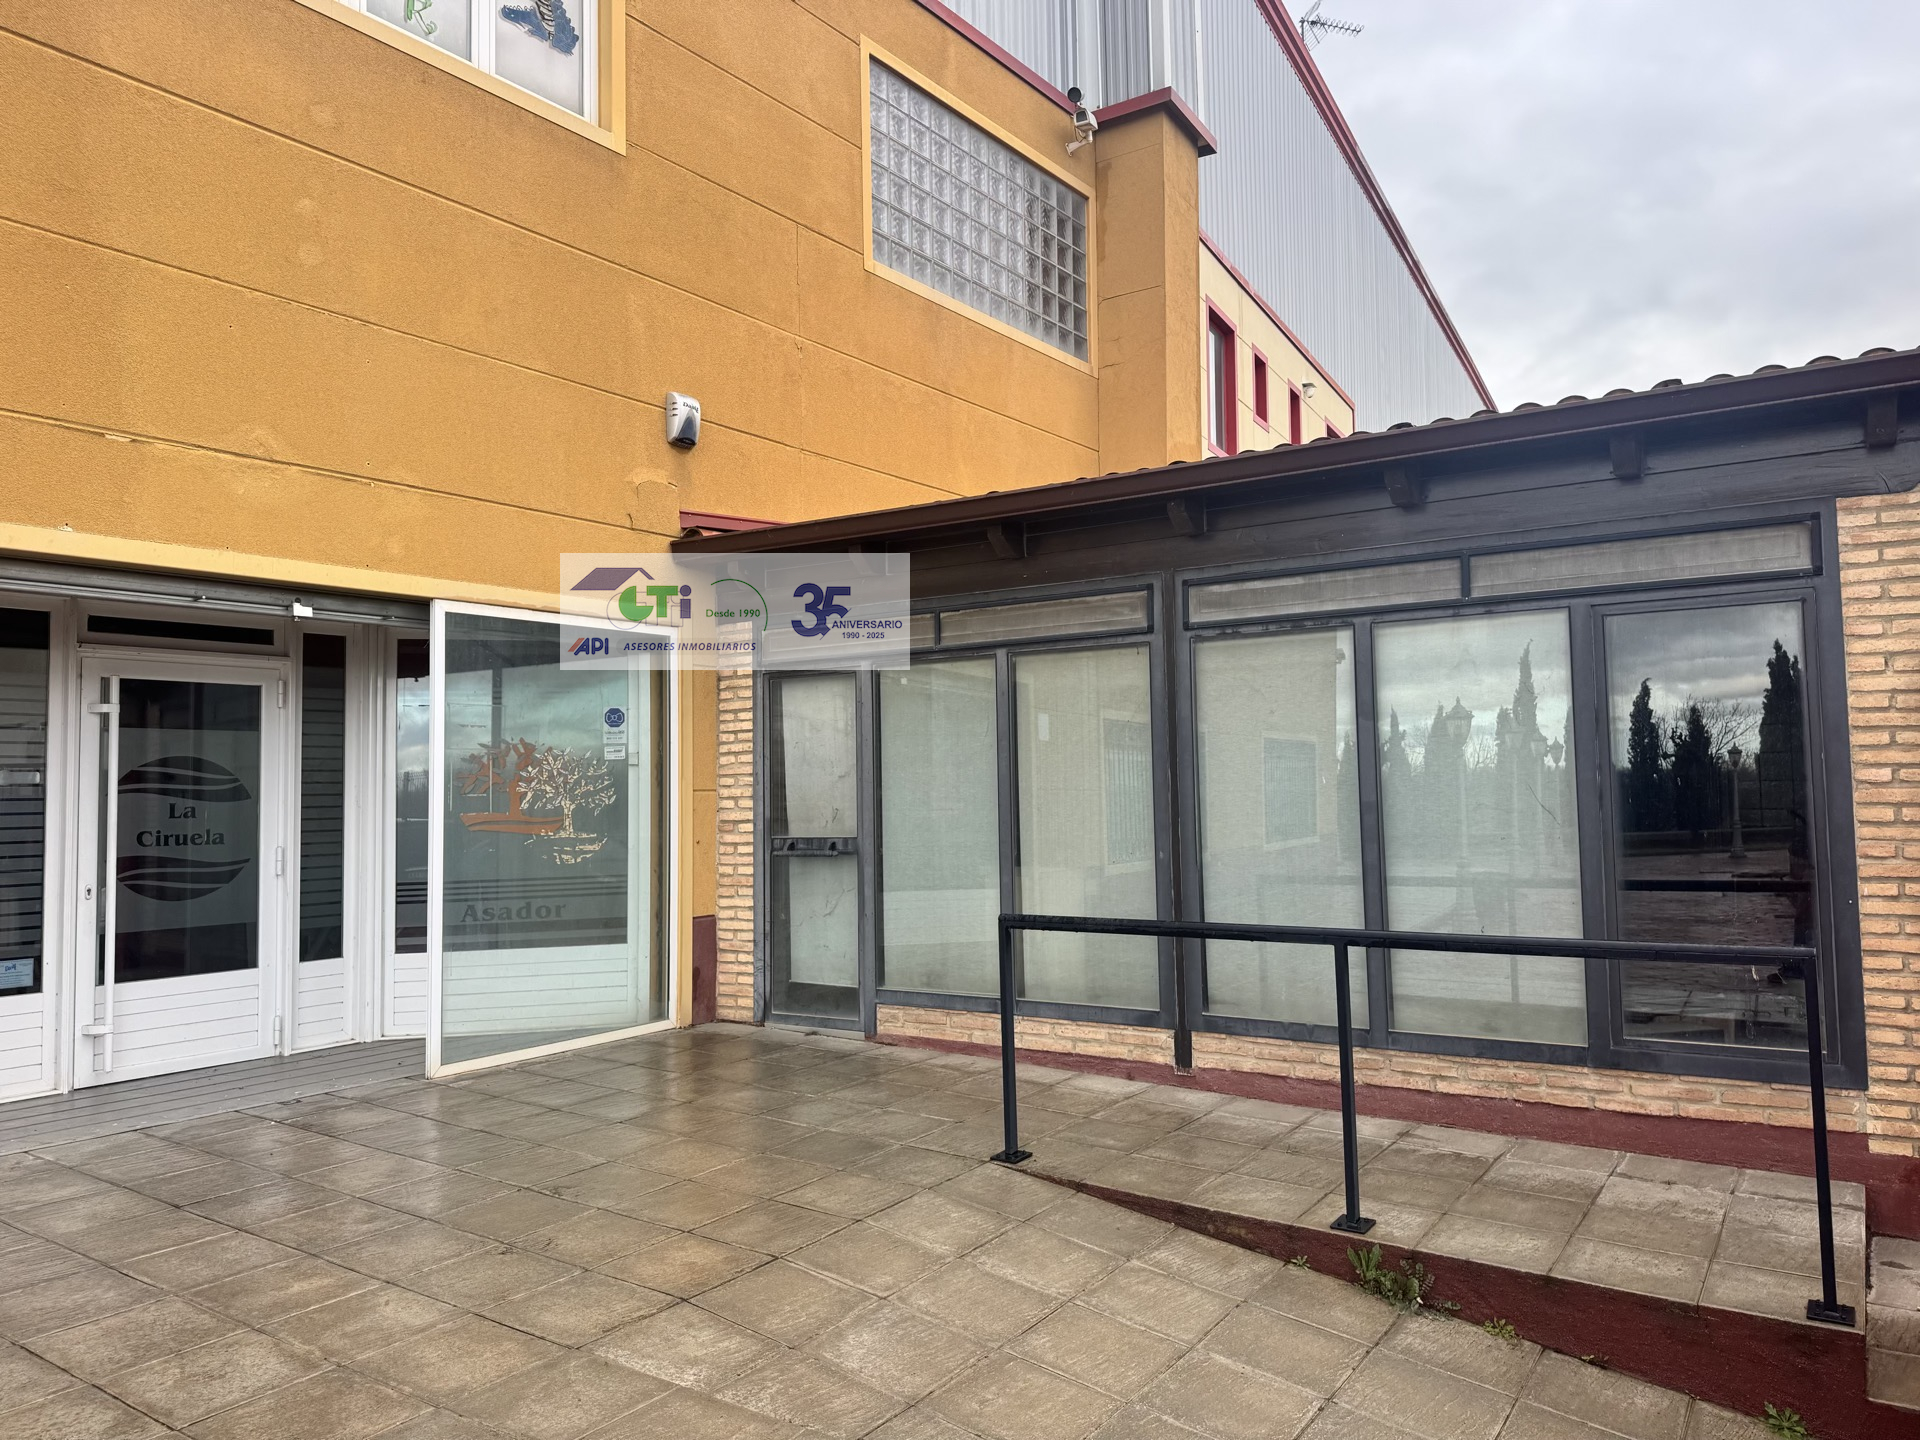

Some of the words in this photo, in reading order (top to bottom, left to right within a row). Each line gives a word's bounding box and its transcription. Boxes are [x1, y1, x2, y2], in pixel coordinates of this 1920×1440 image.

[168, 802, 197, 819] La
[136, 828, 226, 848] Ciruela
[459, 901, 567, 923] Asador
